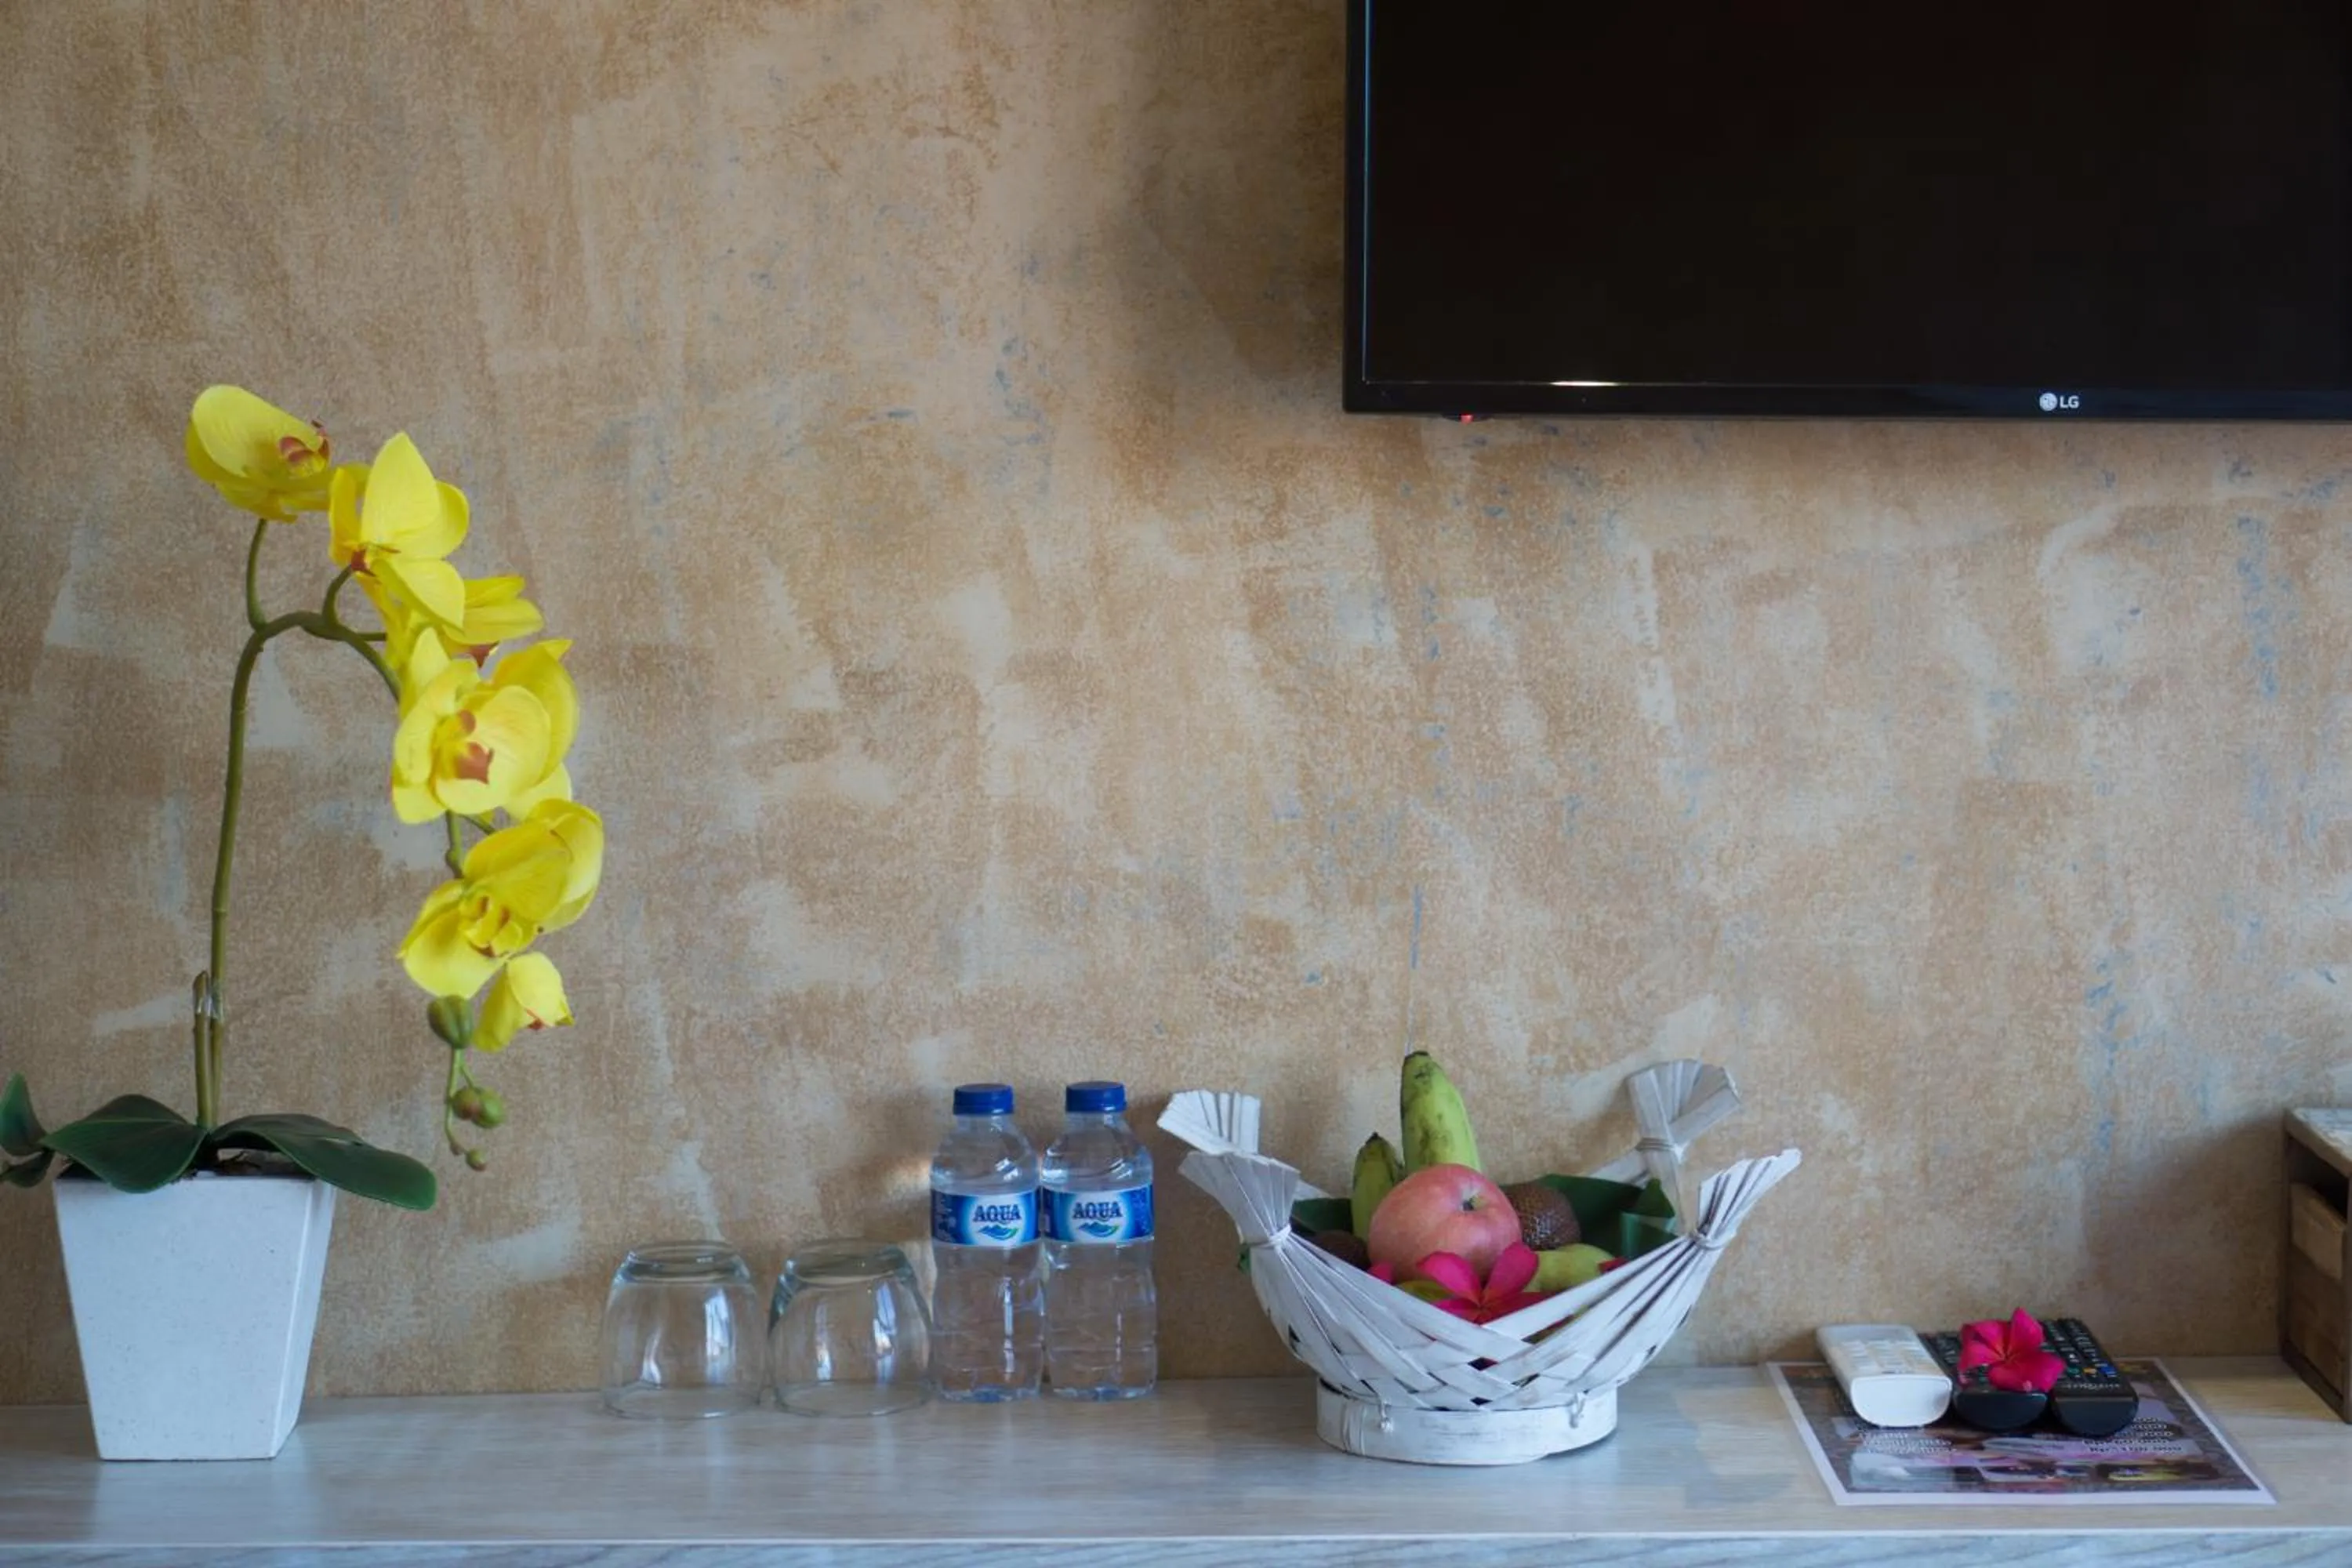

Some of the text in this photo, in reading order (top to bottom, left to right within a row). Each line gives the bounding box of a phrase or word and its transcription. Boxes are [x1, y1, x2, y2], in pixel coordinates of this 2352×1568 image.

[2059, 395, 2079, 408] LG
[973, 1204, 1022, 1223] AQUA
[1073, 1201, 1123, 1221] AQUA
